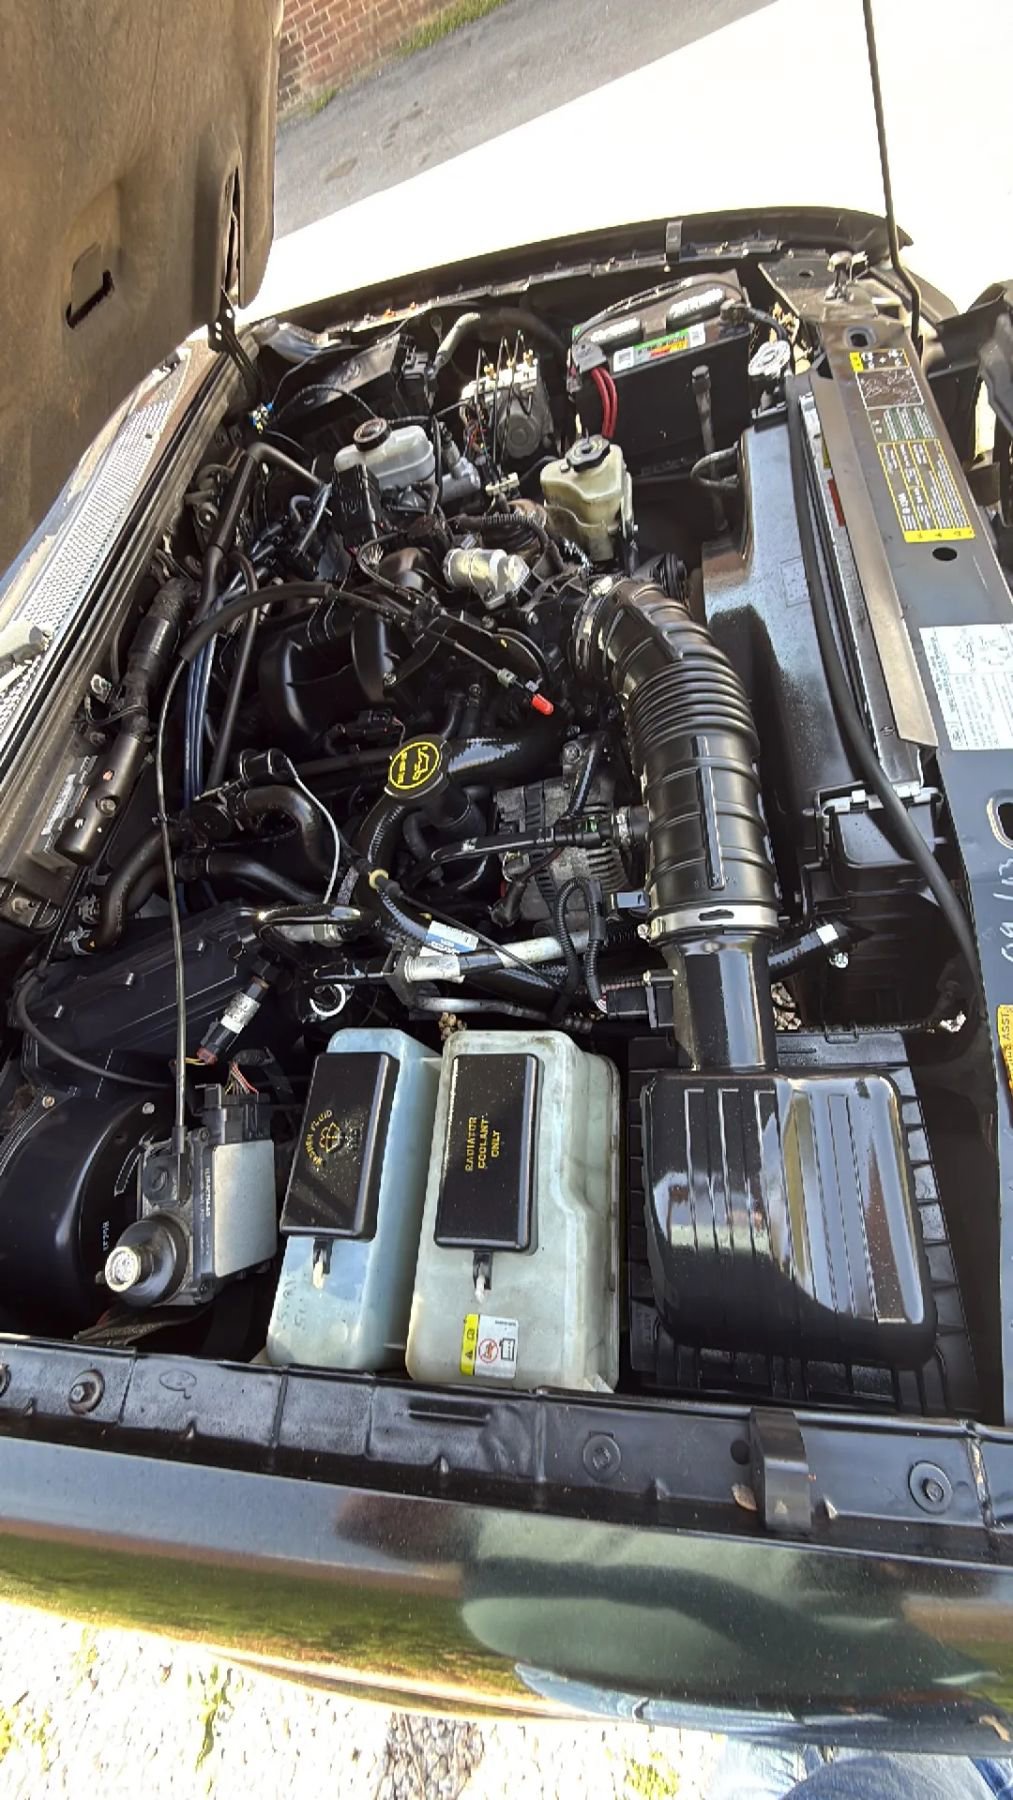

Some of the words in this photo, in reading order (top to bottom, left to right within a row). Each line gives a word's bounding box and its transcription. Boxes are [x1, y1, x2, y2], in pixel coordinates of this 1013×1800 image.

[311, 1109, 333, 1132] FLUID
[465, 1116, 477, 1171] RADIATOR
[478, 1118, 489, 1169] COOLANT
[490, 1130, 501, 1158] ONLY
